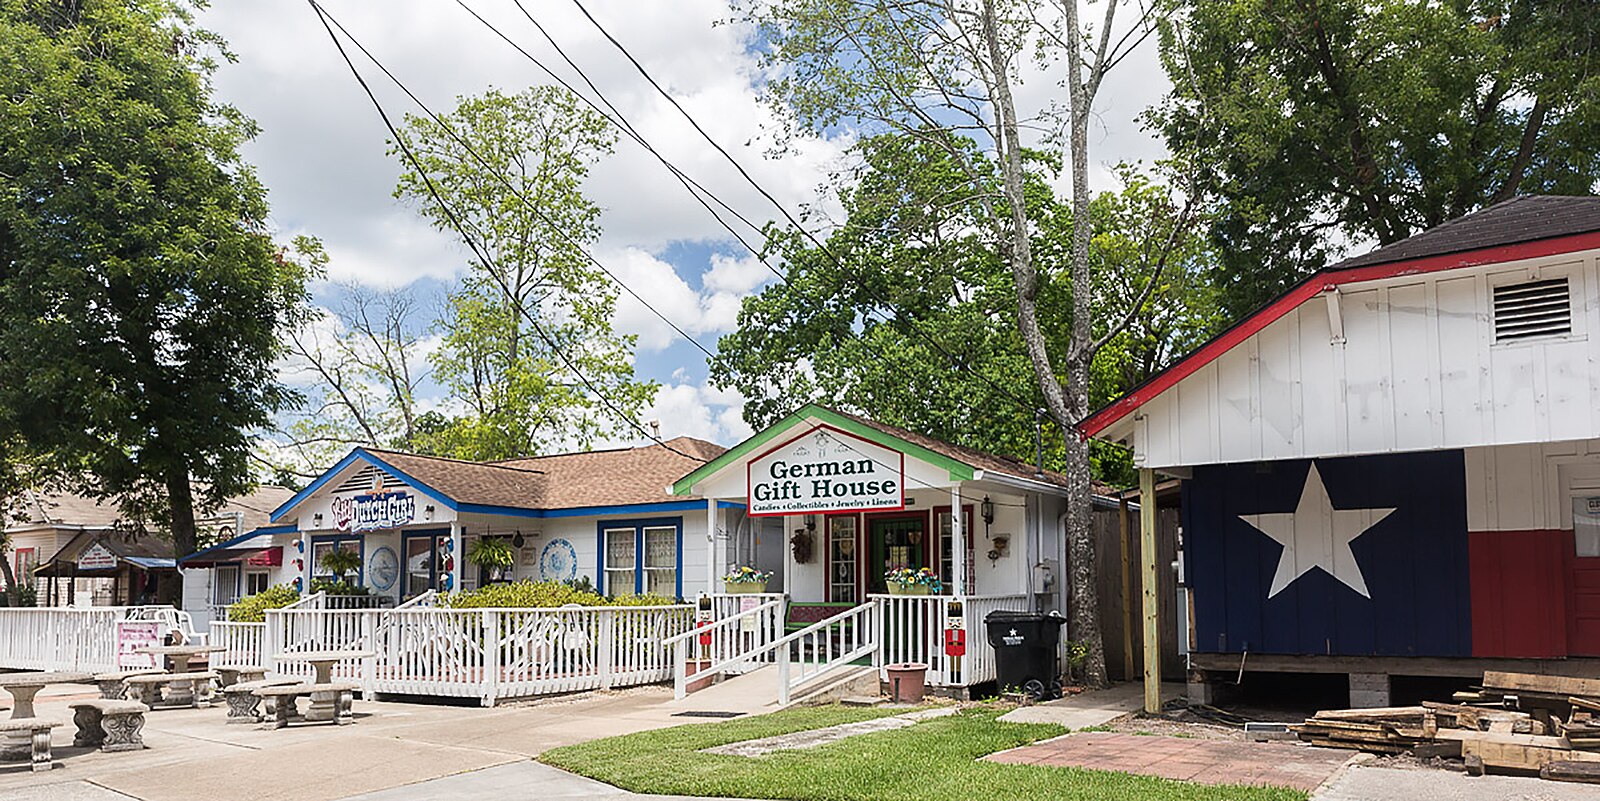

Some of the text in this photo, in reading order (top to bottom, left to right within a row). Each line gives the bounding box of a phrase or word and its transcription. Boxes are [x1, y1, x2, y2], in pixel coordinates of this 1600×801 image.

[770, 459, 875, 479] German
[754, 479, 897, 501] Gift House
[388, 495, 413, 521] GIRL
[753, 503, 780, 512] Candies
[787, 501, 829, 511] Collectibles
[835, 498, 864, 509] Jewelry
[871, 498, 898, 506] Linens
